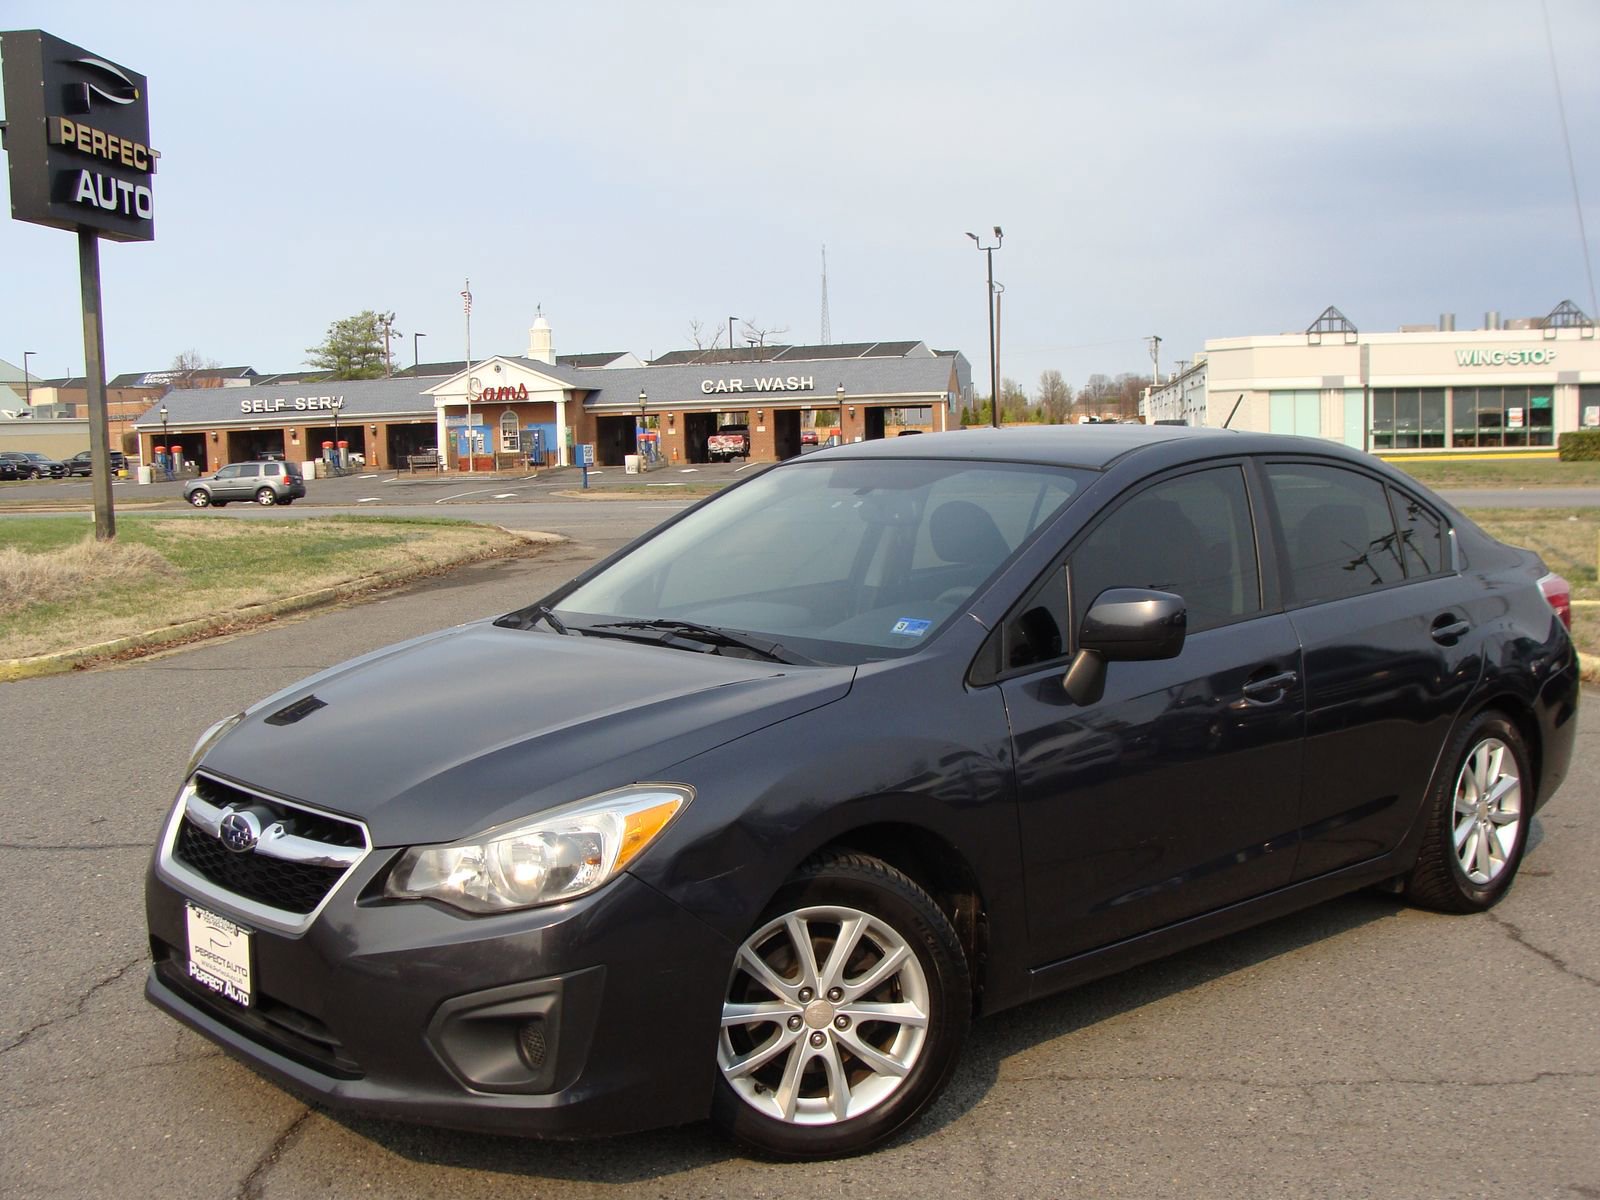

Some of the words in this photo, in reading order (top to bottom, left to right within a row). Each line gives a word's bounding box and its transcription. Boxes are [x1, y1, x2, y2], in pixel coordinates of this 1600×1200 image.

[60, 116, 161, 174] PERFECT
[76, 168, 154, 220] AUTO
[701, 379, 743, 394] CAR
[753, 376, 814, 391] WASH
[240, 398, 287, 413] SELF
[295, 395, 344, 411] SERV
[194, 945, 227, 966] PERFECT
[226, 962, 248, 978] AUTO
[224, 980, 250, 1007] AUTO
